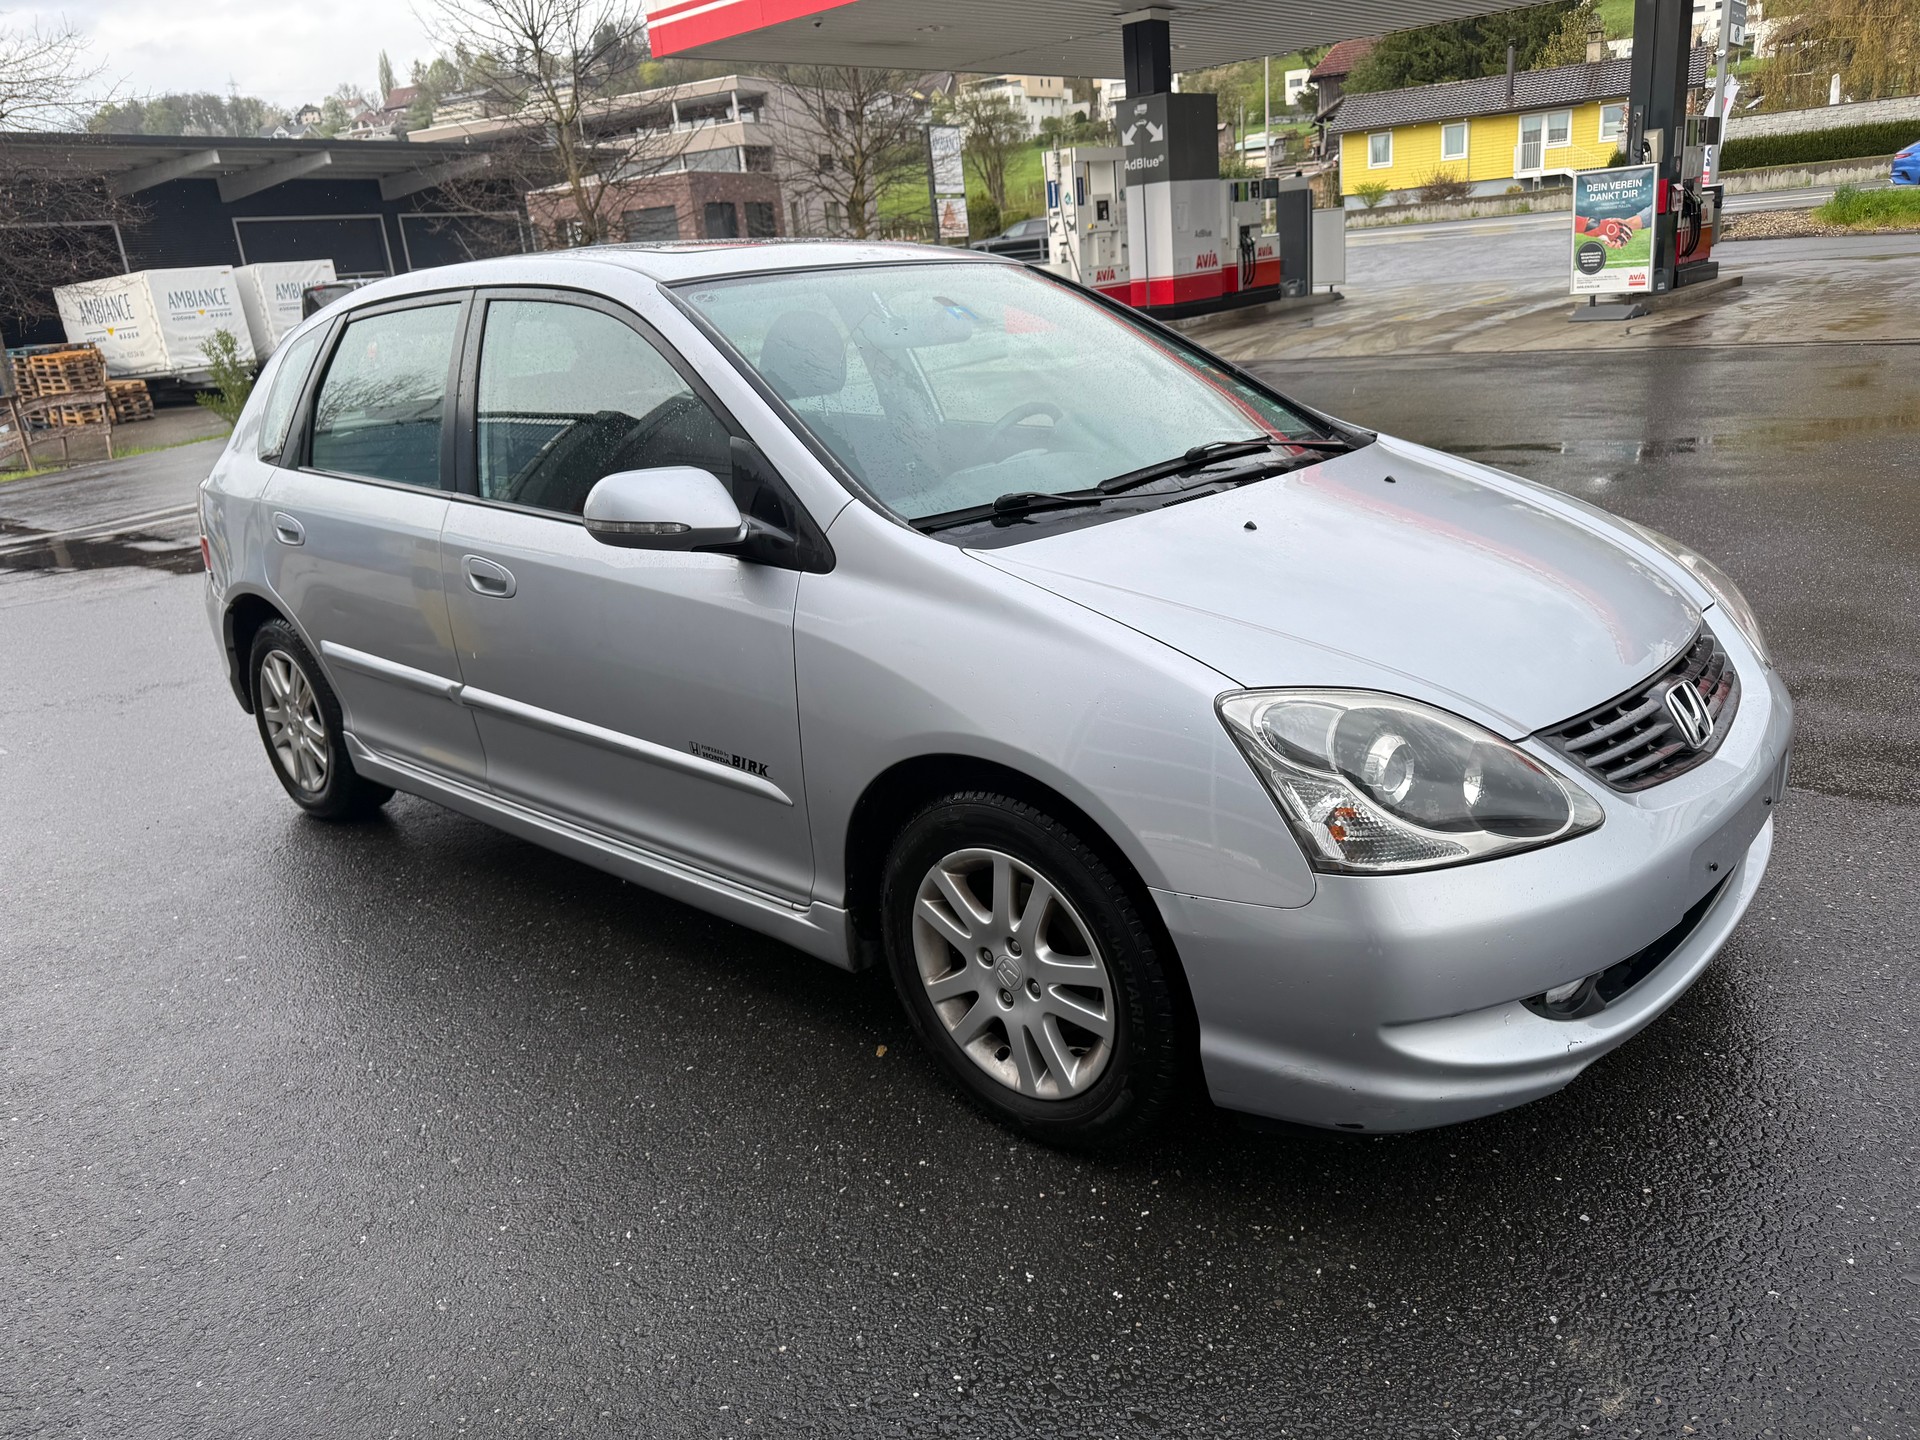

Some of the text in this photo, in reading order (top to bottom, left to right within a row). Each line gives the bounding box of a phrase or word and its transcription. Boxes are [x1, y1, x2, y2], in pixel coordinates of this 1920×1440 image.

[1587, 179, 1642, 192] DEIN VEREIN
[1590, 189, 1638, 201] DANKT DIR
[168, 287, 230, 309] AMBIANCE
[79, 293, 134, 326] AMBIANCE
[702, 751, 732, 766] HONDA
[731, 754, 769, 777] BIRK
